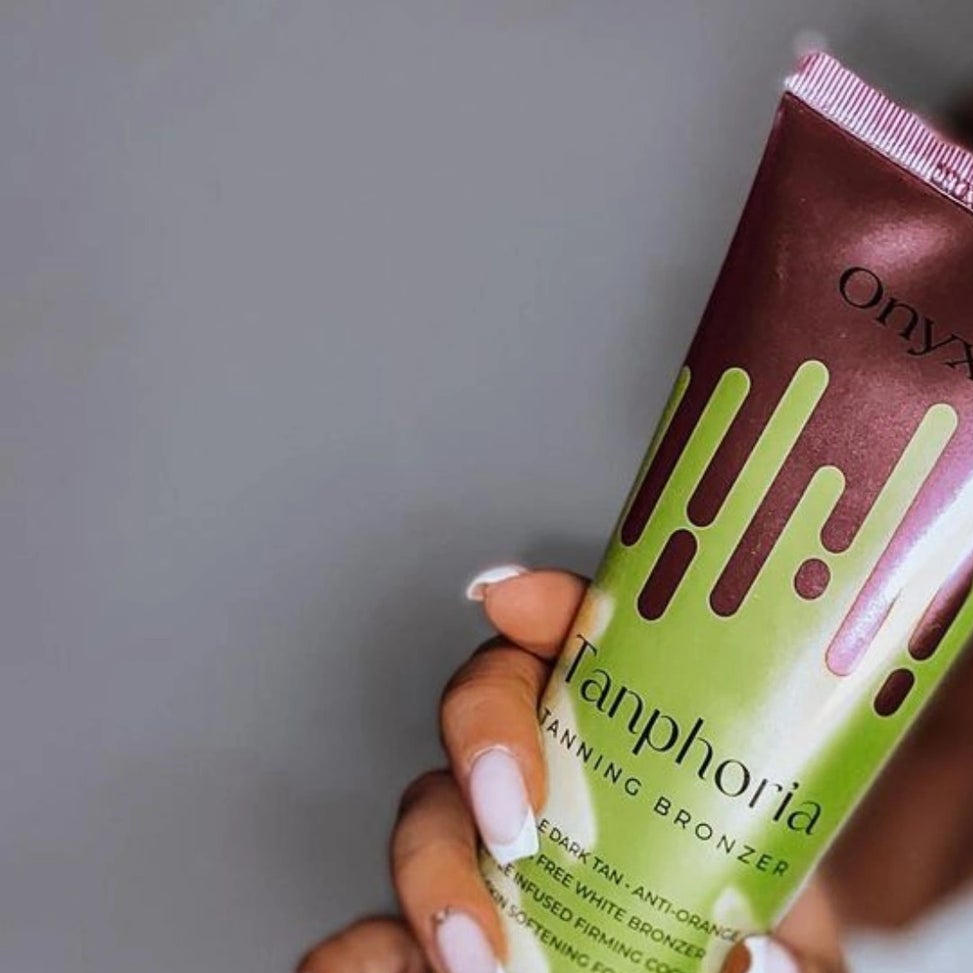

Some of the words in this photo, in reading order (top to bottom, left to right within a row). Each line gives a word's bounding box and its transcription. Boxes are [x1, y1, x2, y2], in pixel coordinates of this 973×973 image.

[564, 633, 823, 836] Tanphoria
[538, 708, 643, 797] TANNING
[653, 796, 789, 877] BRONZER
[549, 827, 591, 864] DARK
[591, 855, 624, 885] TAN
[508, 905, 589, 968] SOFTENING
[514, 872, 573, 922] INFUSED
[574, 917, 642, 964] FIRMING
[575, 882, 628, 922] WHITE
[628, 916, 706, 959] BRONZER
